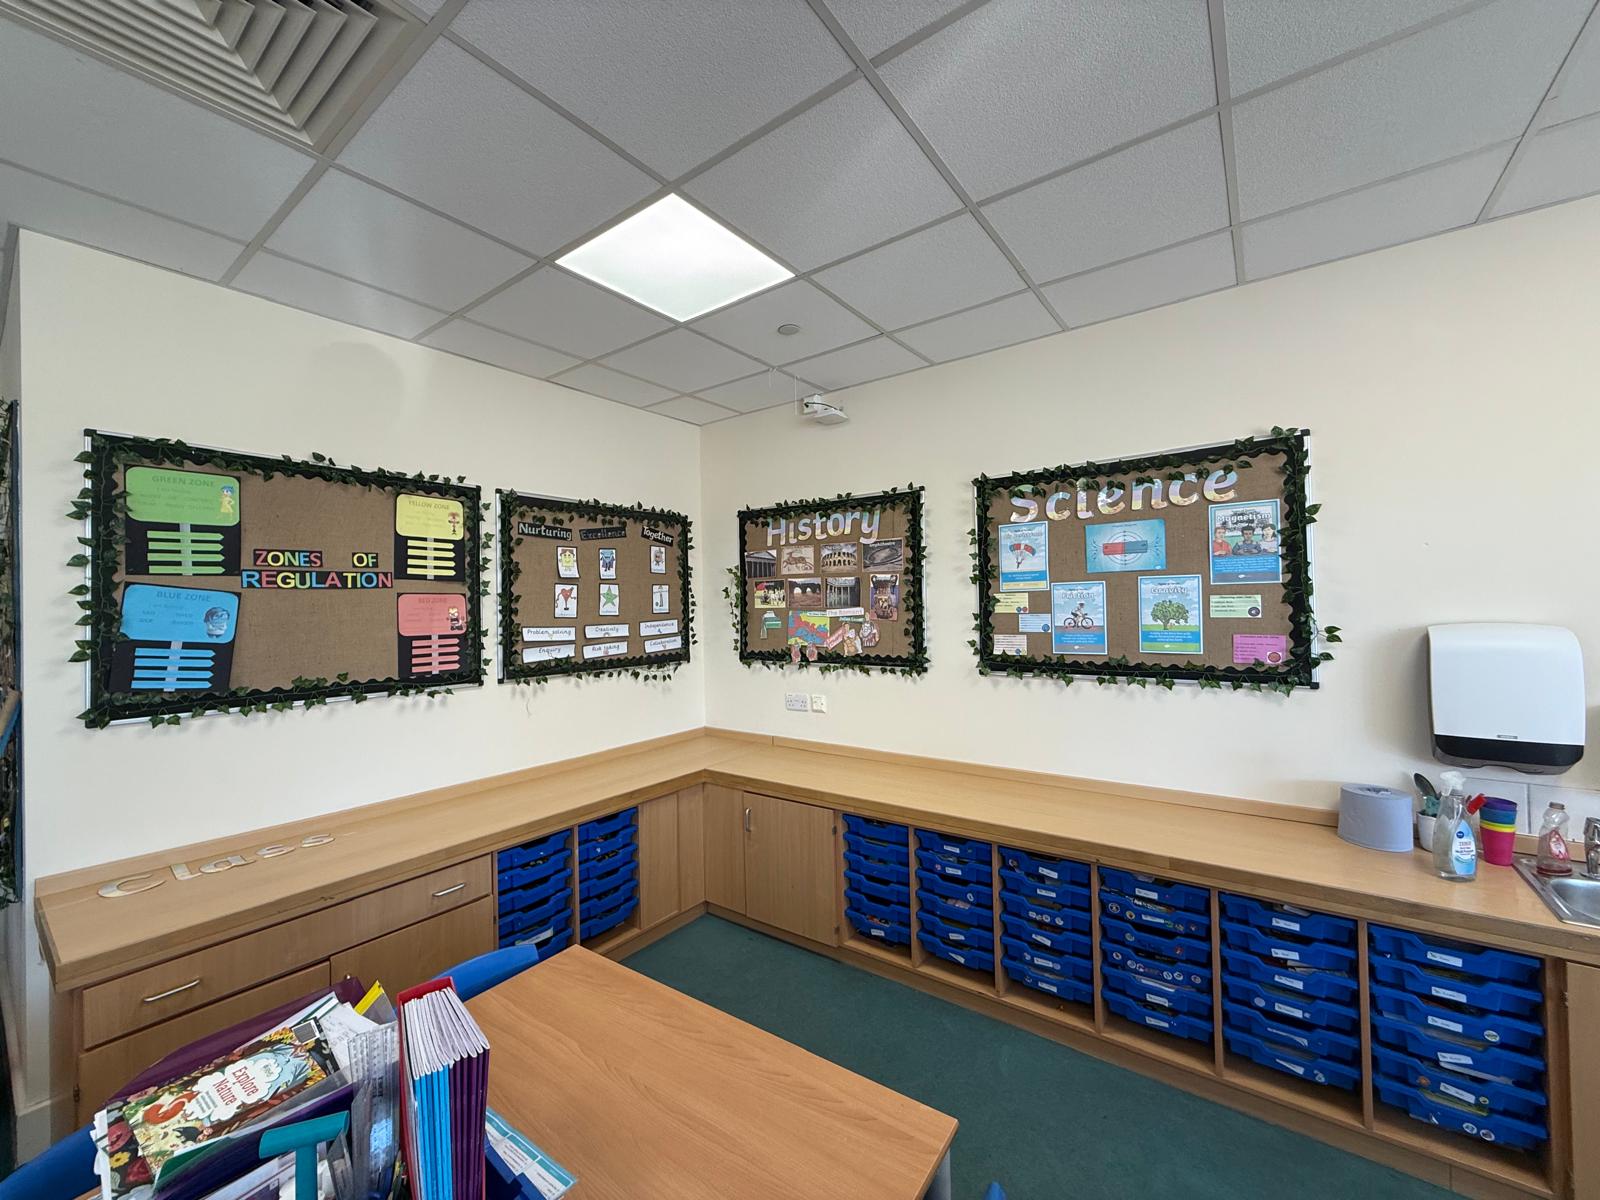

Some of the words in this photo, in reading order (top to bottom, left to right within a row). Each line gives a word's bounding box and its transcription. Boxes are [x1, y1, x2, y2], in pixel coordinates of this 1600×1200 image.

[151, 475, 187, 486] GREEN
[188, 477, 214, 488] ZONE
[408, 499, 433, 509] YELLOW
[1009, 469, 1238, 522] Science
[1216, 512, 1272, 524] Magnetism
[518, 522, 572, 541] Nurturing
[581, 529, 626, 541] Excellence
[643, 525, 674, 544] Together
[766, 510, 881, 547] History
[254, 550, 322, 567] ZONES
[353, 553, 378, 567] OF
[241, 571, 392, 589] REGULATION
[156, 591, 183, 601] BLUE
[184, 593, 212, 602] ZONE
[551, 629, 572, 637] solving
[232, 1066, 259, 1097] Explore
[213, 1078, 238, 1106] Nature
